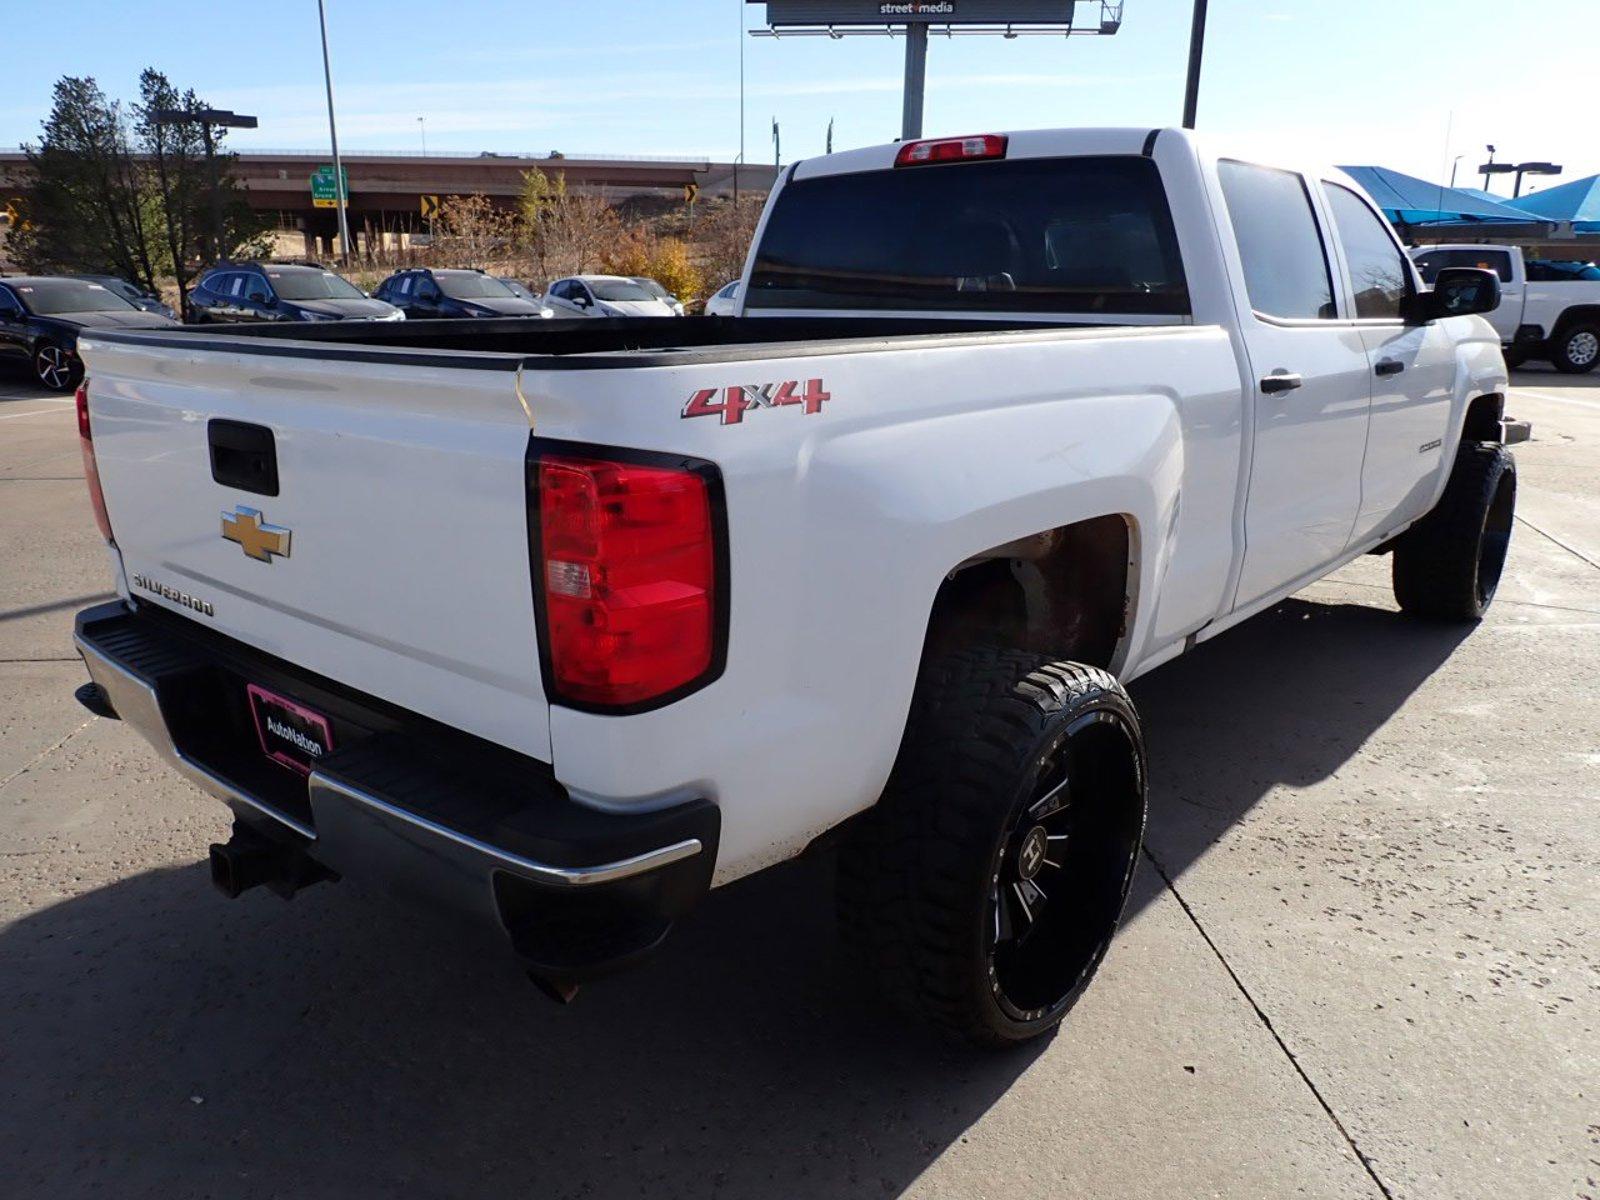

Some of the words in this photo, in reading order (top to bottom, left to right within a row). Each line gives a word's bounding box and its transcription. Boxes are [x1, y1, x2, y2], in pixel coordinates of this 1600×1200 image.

[880, 3, 912, 13] street
[919, 1, 953, 13] media
[133, 572, 214, 617] SILVERADO
[267, 716, 322, 755] AutoNation
